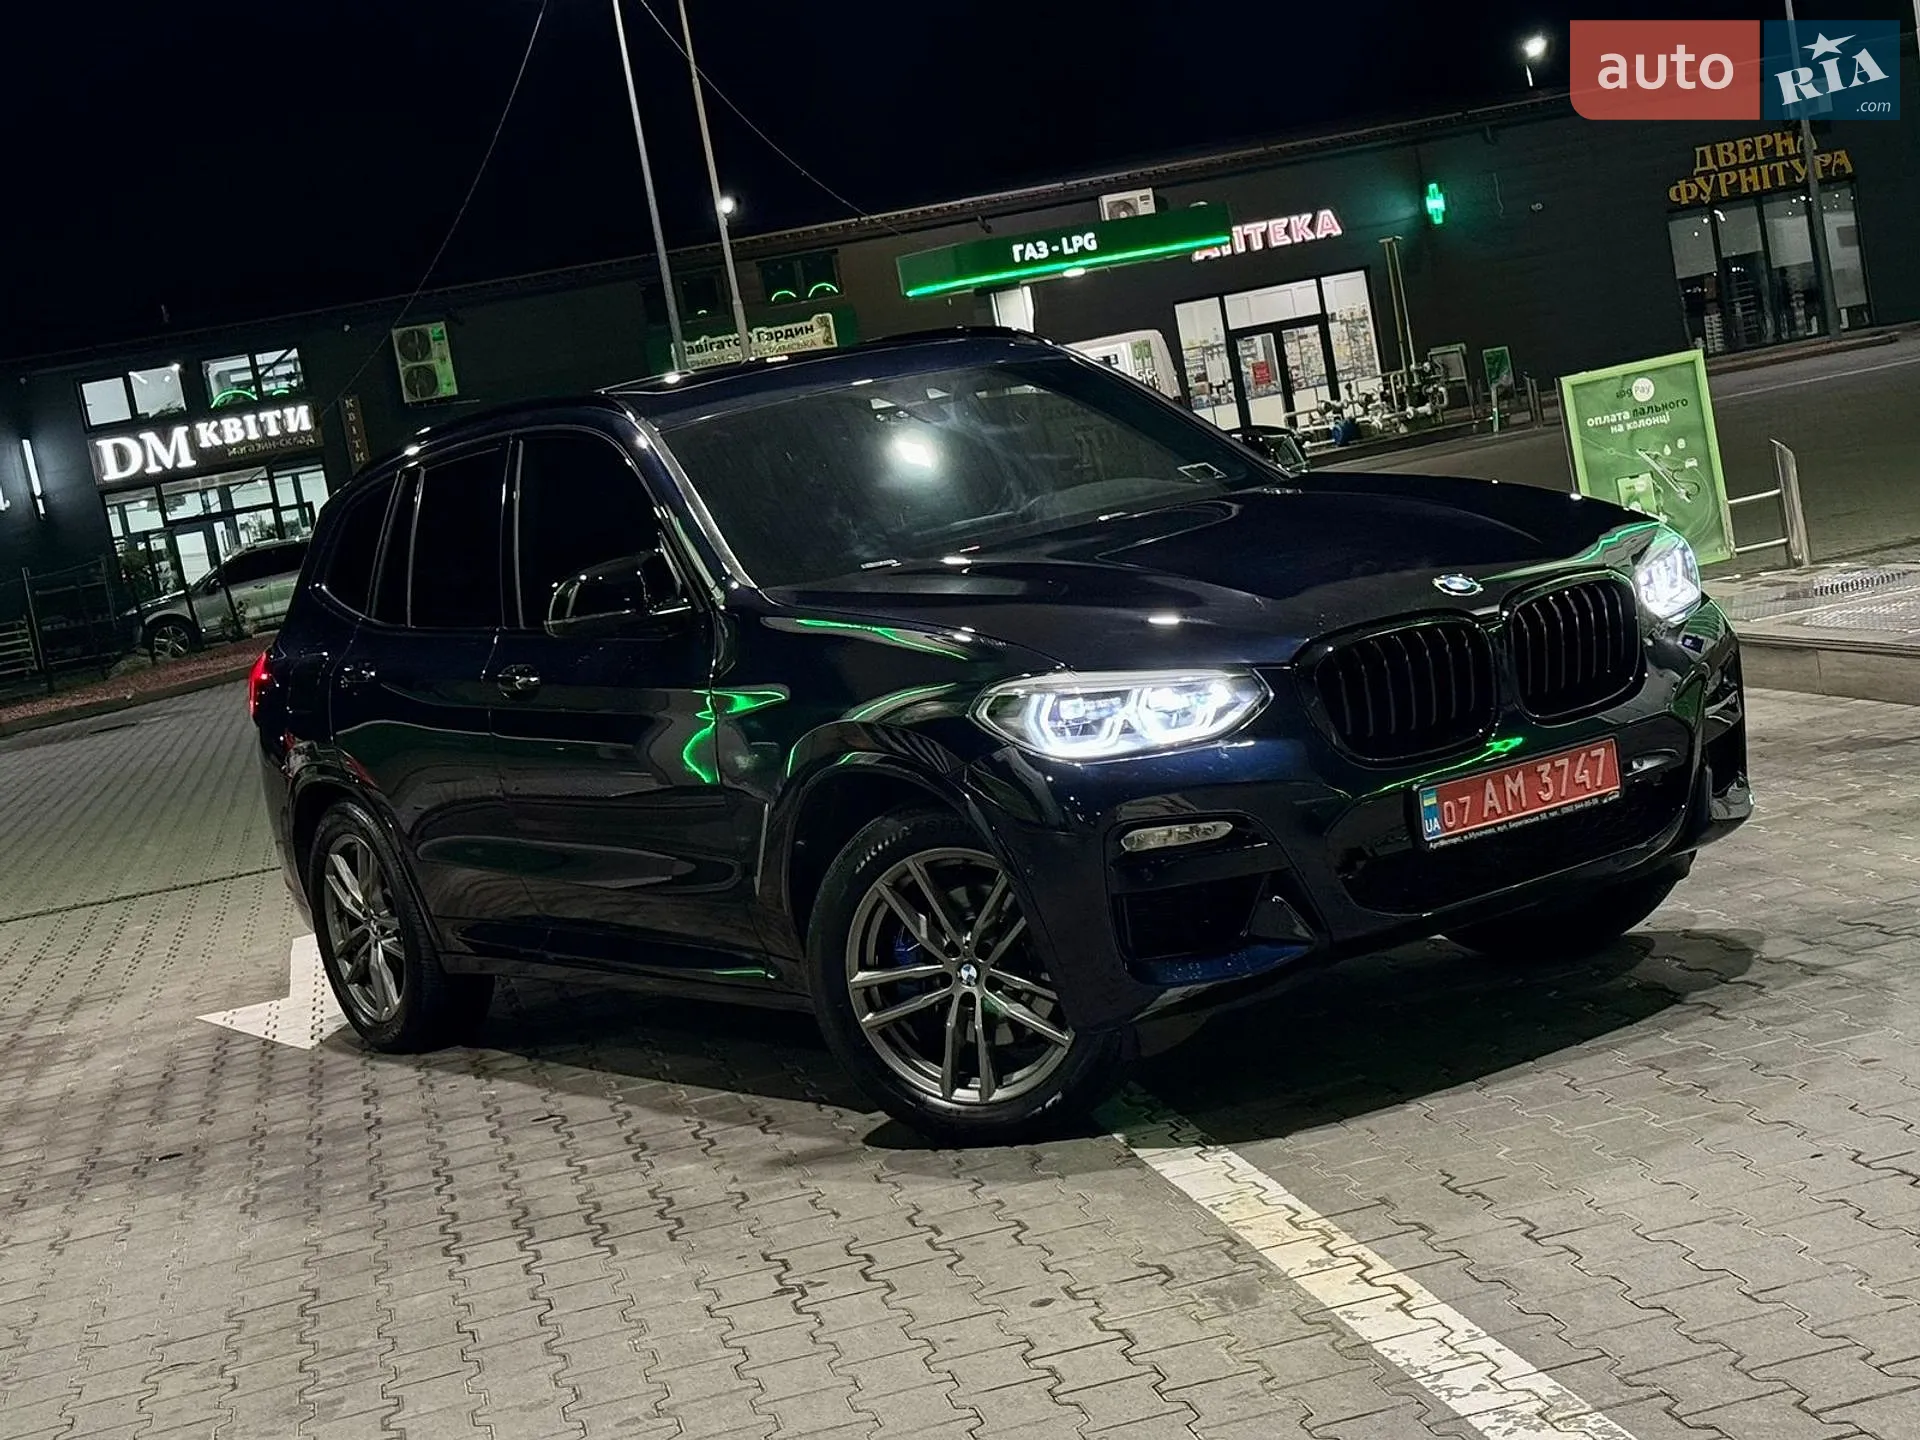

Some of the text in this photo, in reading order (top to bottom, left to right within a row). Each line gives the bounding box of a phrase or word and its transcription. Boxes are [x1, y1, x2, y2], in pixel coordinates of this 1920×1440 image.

[1668, 148, 1854, 205] ФУРНІТУРА
[1012, 240, 1049, 263] ГАЗ
[1061, 232, 1098, 255] LPG
[685, 331, 753, 356] авігато
[757, 323, 815, 344] Гардин
[197, 406, 313, 449] КВІТИ
[1586, 397, 1689, 428] оплата пального
[1610, 411, 1671, 434] на колонці
[96, 428, 197, 482] DM
[1443, 795, 1472, 829] 07
[1482, 770, 1527, 818] AM
[1536, 747, 1606, 802] 3747
[1424, 817, 1441, 833] UA
